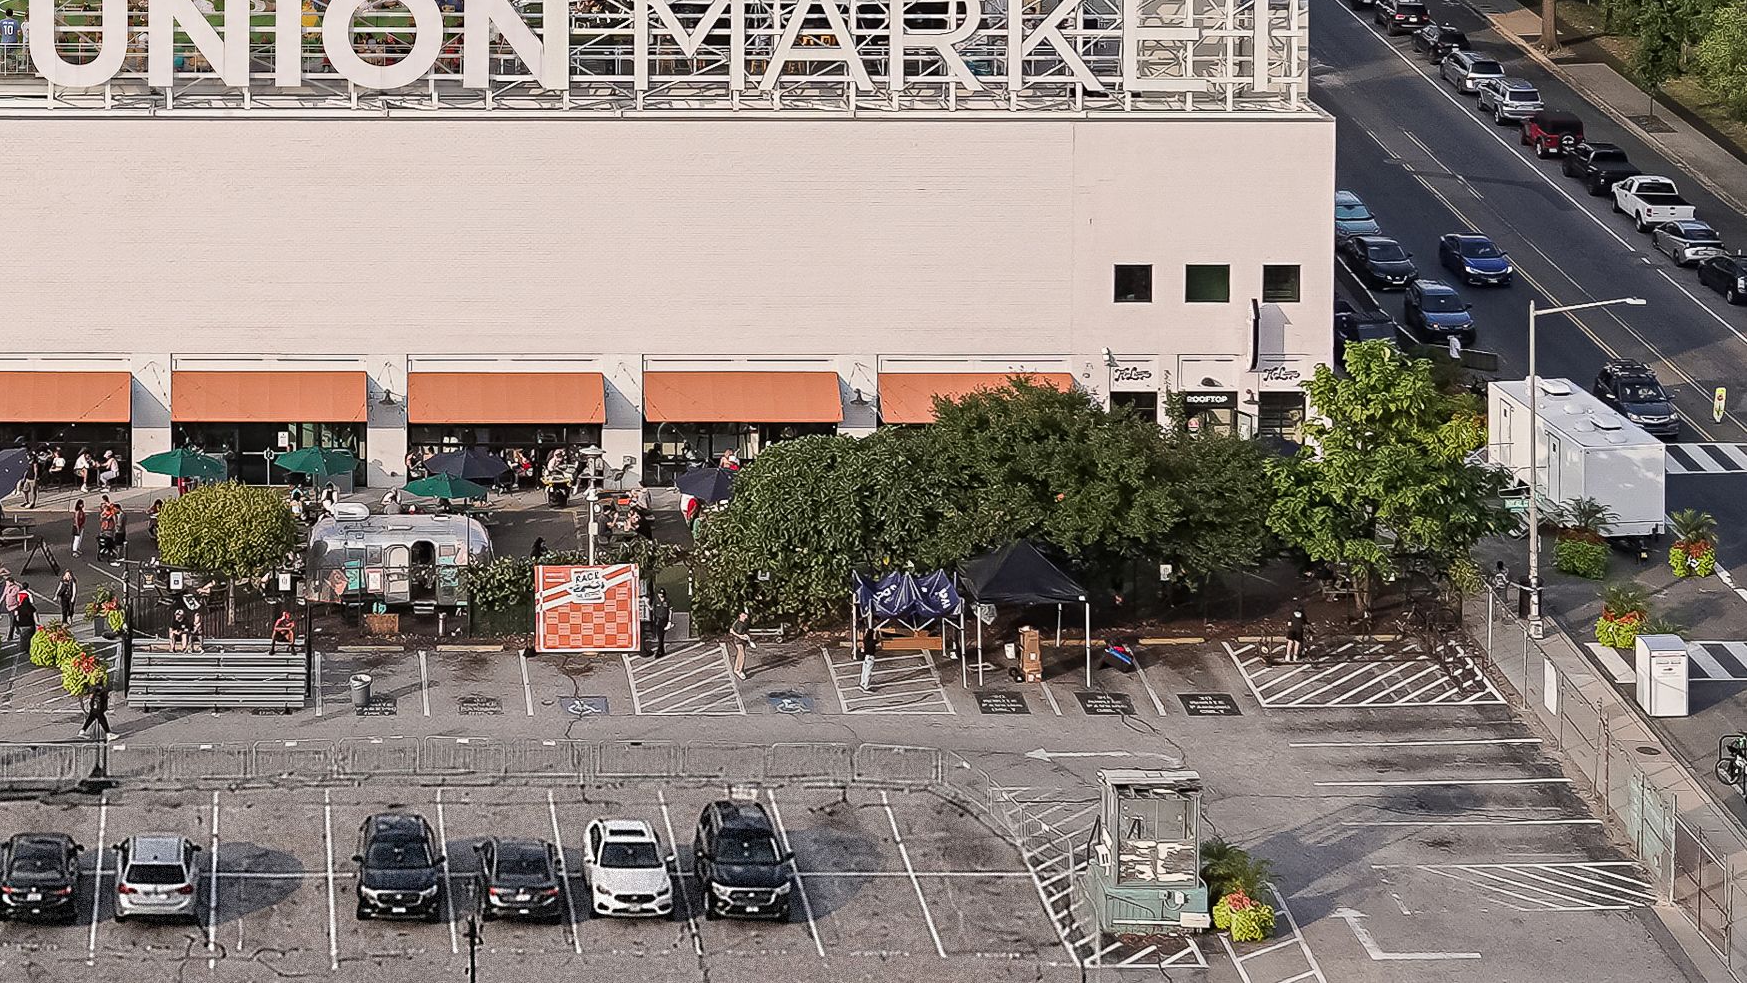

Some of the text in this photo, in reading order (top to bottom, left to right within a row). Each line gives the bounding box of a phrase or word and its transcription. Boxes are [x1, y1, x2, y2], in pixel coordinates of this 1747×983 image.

[3, 25, 14, 35] 10
[1186, 395, 1228, 403] ROOFTOP
[575, 571, 600, 583] RACE
